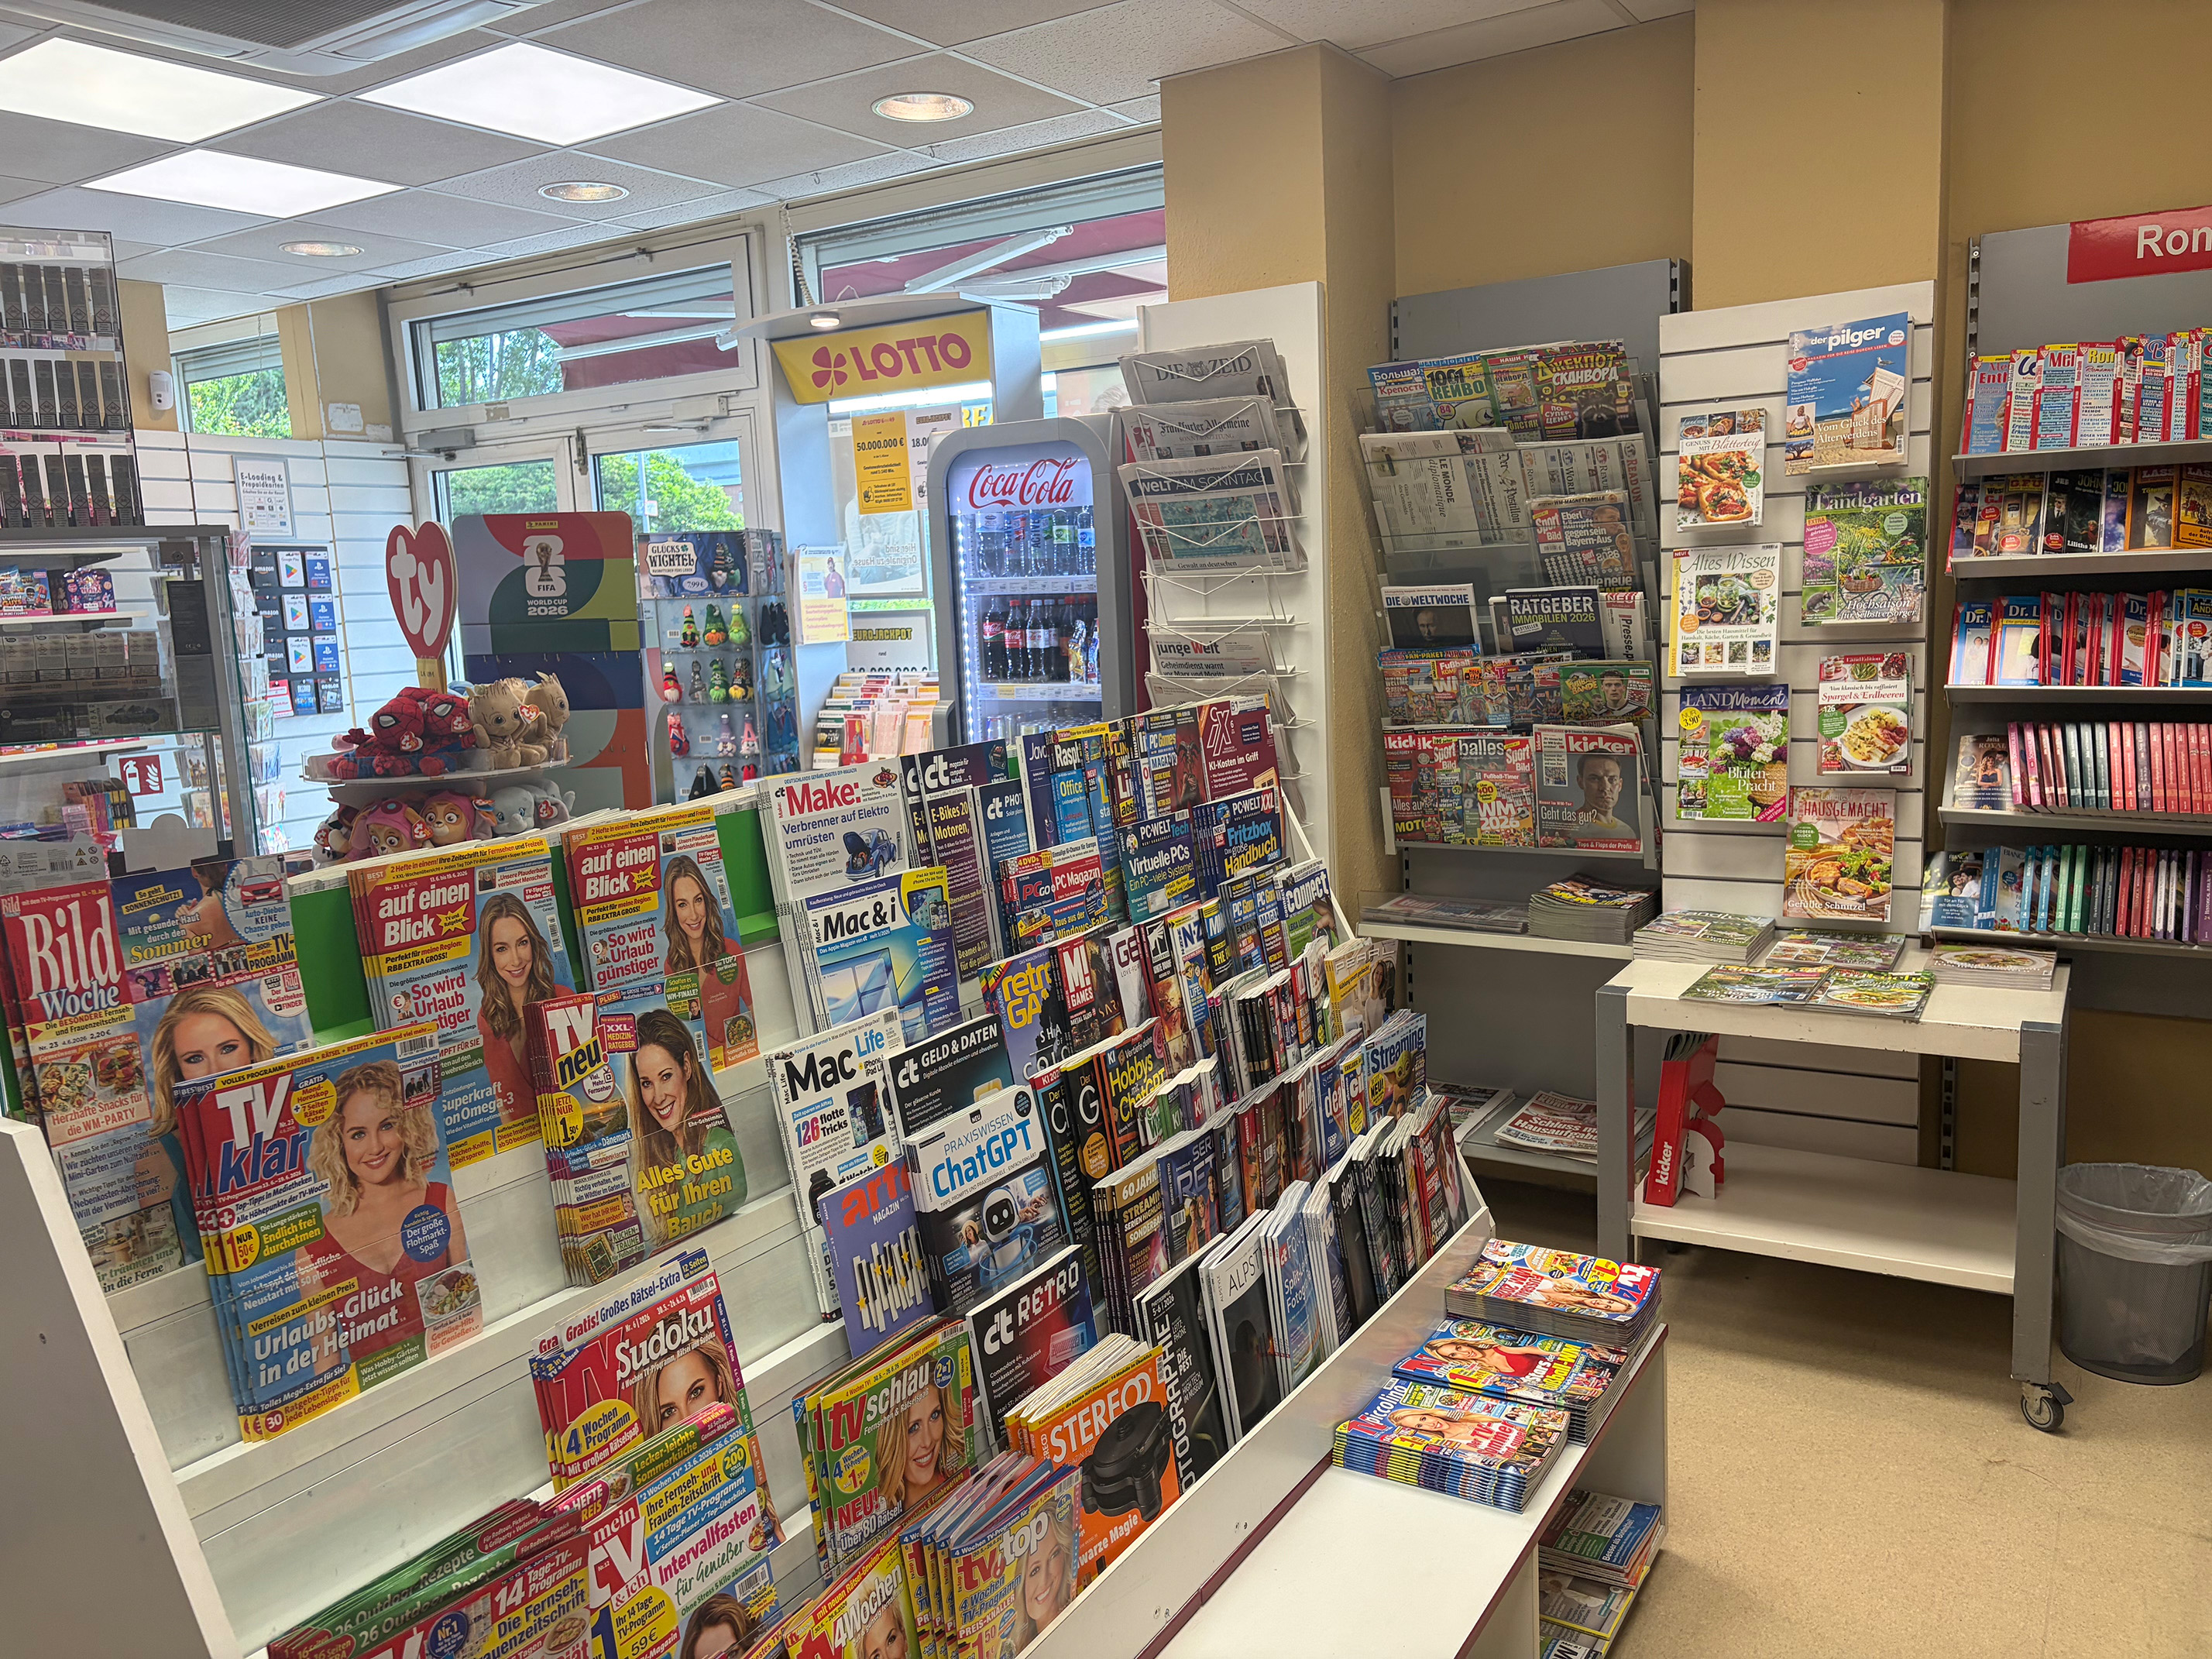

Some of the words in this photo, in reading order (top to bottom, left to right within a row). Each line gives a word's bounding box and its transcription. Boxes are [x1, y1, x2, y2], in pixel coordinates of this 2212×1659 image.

[1811, 336, 1827, 346] der
[1828, 326, 1885, 352] pilger
[850, 333, 971, 381] LOTTO
[1156, 364, 1183, 381] DIE
[1427, 367, 1464, 386] 1001
[1552, 366, 1619, 386] СКАНВОРД
[1379, 383, 1424, 396] Крепость
[1431, 380, 1488, 400] КЕЙВО
[1158, 421, 1204, 435] Frankfurter
[1204, 417, 1249, 431] Allgemeine
[1817, 423, 1839, 432] Vom
[1840, 419, 1869, 428] Glück
[1870, 417, 1887, 425] des
[1817, 428, 1878, 443] Älterwerdens
[857, 438, 898, 452] 50.000.000
[899, 438, 904, 446] €
[240, 472, 276, 482] E-Loading
[969, 458, 1080, 509] Coca-Cola
[1199, 472, 1266, 487] SONNTAG
[1429, 459, 1447, 517] diplomatique
[1440, 470, 1455, 503] MONDE
[1815, 490, 1922, 514] Landgarten
[1535, 515, 1560, 534] Sport
[1561, 511, 1582, 520] Eberl
[1546, 531, 1562, 541] Bild
[1565, 535, 1612, 547] Bayern-Aus
[649, 554, 694, 567] WICHTEL
[652, 544, 680, 554] GLÜCKS
[1679, 553, 1722, 572] Altes
[1726, 555, 1775, 569] Wissen
[390, 534, 442, 647] ty
[1386, 596, 1401, 606] DIE
[1410, 594, 1469, 606] WELTWOCHE
[527, 606, 568, 615] 2026
[1510, 597, 1594, 614] RATGEBER
[1846, 599, 1910, 609] Hochsaison
[1856, 608, 1916, 619] Selbstversorger
[2008, 606, 2030, 617] Dr.
[1512, 613, 1568, 623] IMMOBILIEN
[1570, 613, 1595, 622] 2026
[1514, 623, 1538, 634] BESTSELLER
[852, 628, 912, 641] EUROJACKPOT
[1156, 644, 1189, 658] junge
[1190, 641, 1220, 654] Welt
[1685, 693, 1731, 707] LAND
[1822, 692, 1853, 701] Spargel
[1861, 690, 1905, 699] Erdbeeren
[1434, 743, 1455, 763] Sport
[1568, 736, 1633, 753] kicker
[1442, 761, 1456, 769] Bild
[1728, 766, 1770, 779] Blüten-
[785, 779, 861, 816] Make:
[1737, 779, 1775, 792] Pracht
[782, 816, 839, 835] Verbrenner
[840, 812, 856, 823] auf
[858, 805, 889, 819] Elektro
[1540, 807, 1560, 821] Geht
[1561, 809, 1576, 821] das
[1578, 809, 1597, 823] gut?
[1804, 801, 1887, 817] HAUSGEMACHT
[1227, 819, 1273, 844] Fritzbox
[1480, 816, 1520, 830] 2026
[785, 830, 835, 850] umrüsten
[581, 854, 617, 875] auf
[620, 843, 656, 865] einen
[1128, 853, 1168, 877] Virtuelle
[1169, 844, 1190, 864] PCs
[1224, 835, 1277, 877] Handbuch
[586, 871, 630, 900] Blick
[1286, 872, 1329, 912] connect
[378, 894, 415, 919] auf
[418, 880, 470, 908] einen
[1788, 900, 1822, 910] Gefüllte
[1825, 901, 1866, 912] Schnitzel
[129, 926, 142, 936] Mit
[143, 918, 179, 933] gesunder
[180, 913, 201, 924] Haut
[383, 915, 434, 947] Blick
[824, 910, 864, 942] Mac
[865, 902, 887, 931] &
[890, 897, 897, 922] i
[19, 895, 122, 1000] Bild
[130, 932, 212, 963] Sommer
[249, 951, 295, 971] PROGRAMM
[38, 980, 119, 1020] Woche
[1070, 987, 1094, 1007] GAMES
[547, 1003, 597, 1056] TV
[559, 1025, 610, 1088] neu!
[920, 1039, 950, 1068] GELD
[951, 1037, 960, 1053] &
[960, 1023, 998, 1052] DATEN
[1370, 1026, 1424, 1068] Streaming
[785, 1049, 857, 1101] Mac
[856, 1030, 884, 1057] Life
[1110, 1053, 1153, 1097] Hobbys
[215, 1074, 292, 1151] TV
[943, 1111, 1015, 1156] PRAXISWISSEN
[218, 1129, 307, 1196] klar
[637, 1163, 685, 1194] Alles
[686, 1146, 733, 1174] Gute
[932, 1119, 1032, 1200] ChatGPT
[1655, 1142, 1672, 1185] kicker
[649, 1195, 680, 1216] für
[684, 1173, 733, 1204] Ihren
[668, 1201, 723, 1238] Bauch
[873, 1202, 901, 1226] MAGAZIN
[566, 1310, 599, 1341] Gratis!
[600, 1296, 629, 1322] Großes
[630, 1269, 681, 1306] Rätsel-Extra
[1018, 1260, 1079, 1326] RETRO
[254, 1279, 404, 1361] Urlaubs-Glück
[259, 1363, 280, 1386] in
[286, 1349, 319, 1376] der
[324, 1305, 399, 1356] Heimat
[615, 1304, 713, 1379] Sudoku
[1177, 1348, 1187, 1365] DIE
[1179, 1355, 1192, 1376] PEST
[1368, 1385, 1407, 1425] piccolino
[837, 1487, 880, 1530] NEU!
[593, 1506, 637, 1541] mein
[658, 1502, 757, 1585] Intervallfasten
[1001, 1512, 1049, 1566] top
[675, 1572, 694, 1605] für
[697, 1539, 745, 1581] Genießer
